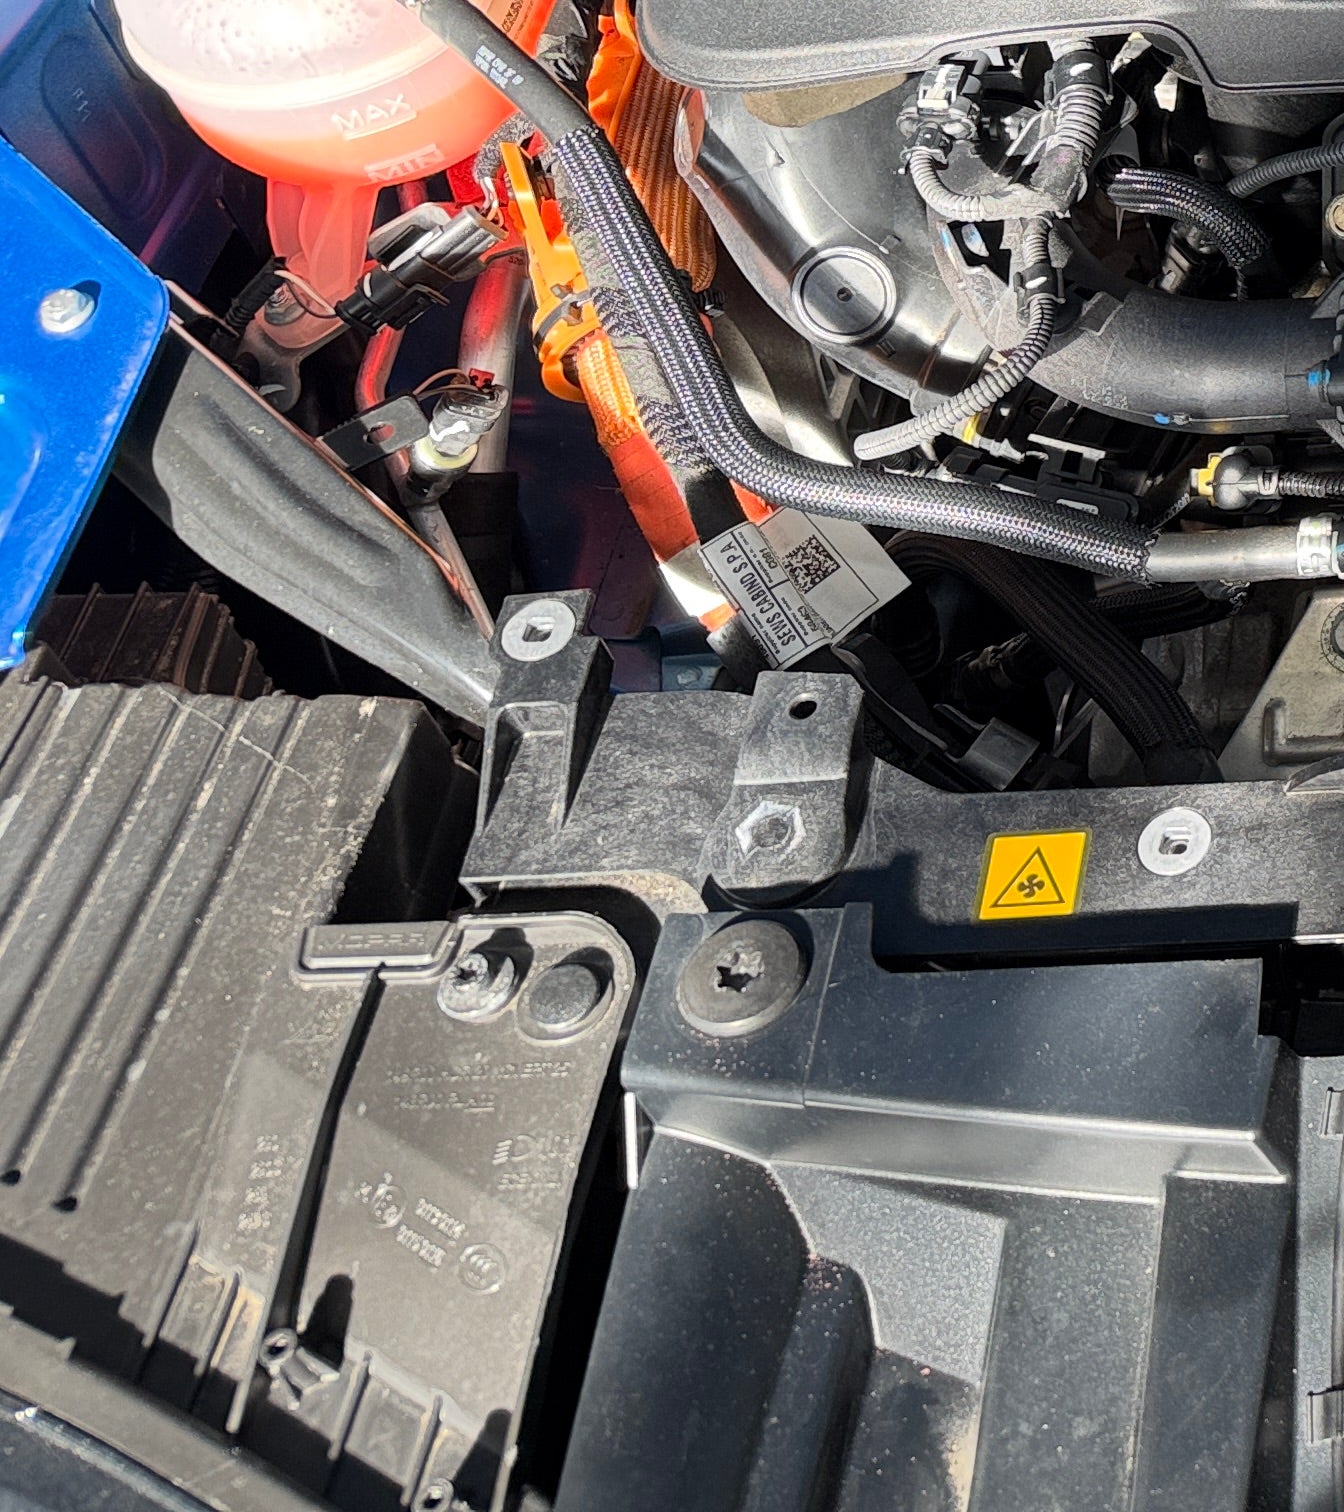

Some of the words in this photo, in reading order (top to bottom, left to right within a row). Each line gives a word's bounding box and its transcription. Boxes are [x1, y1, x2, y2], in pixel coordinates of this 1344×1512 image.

[331, 93, 411, 133] MAX
[739, 572, 775, 614] CABIND
[766, 613, 797, 646] SEWS
